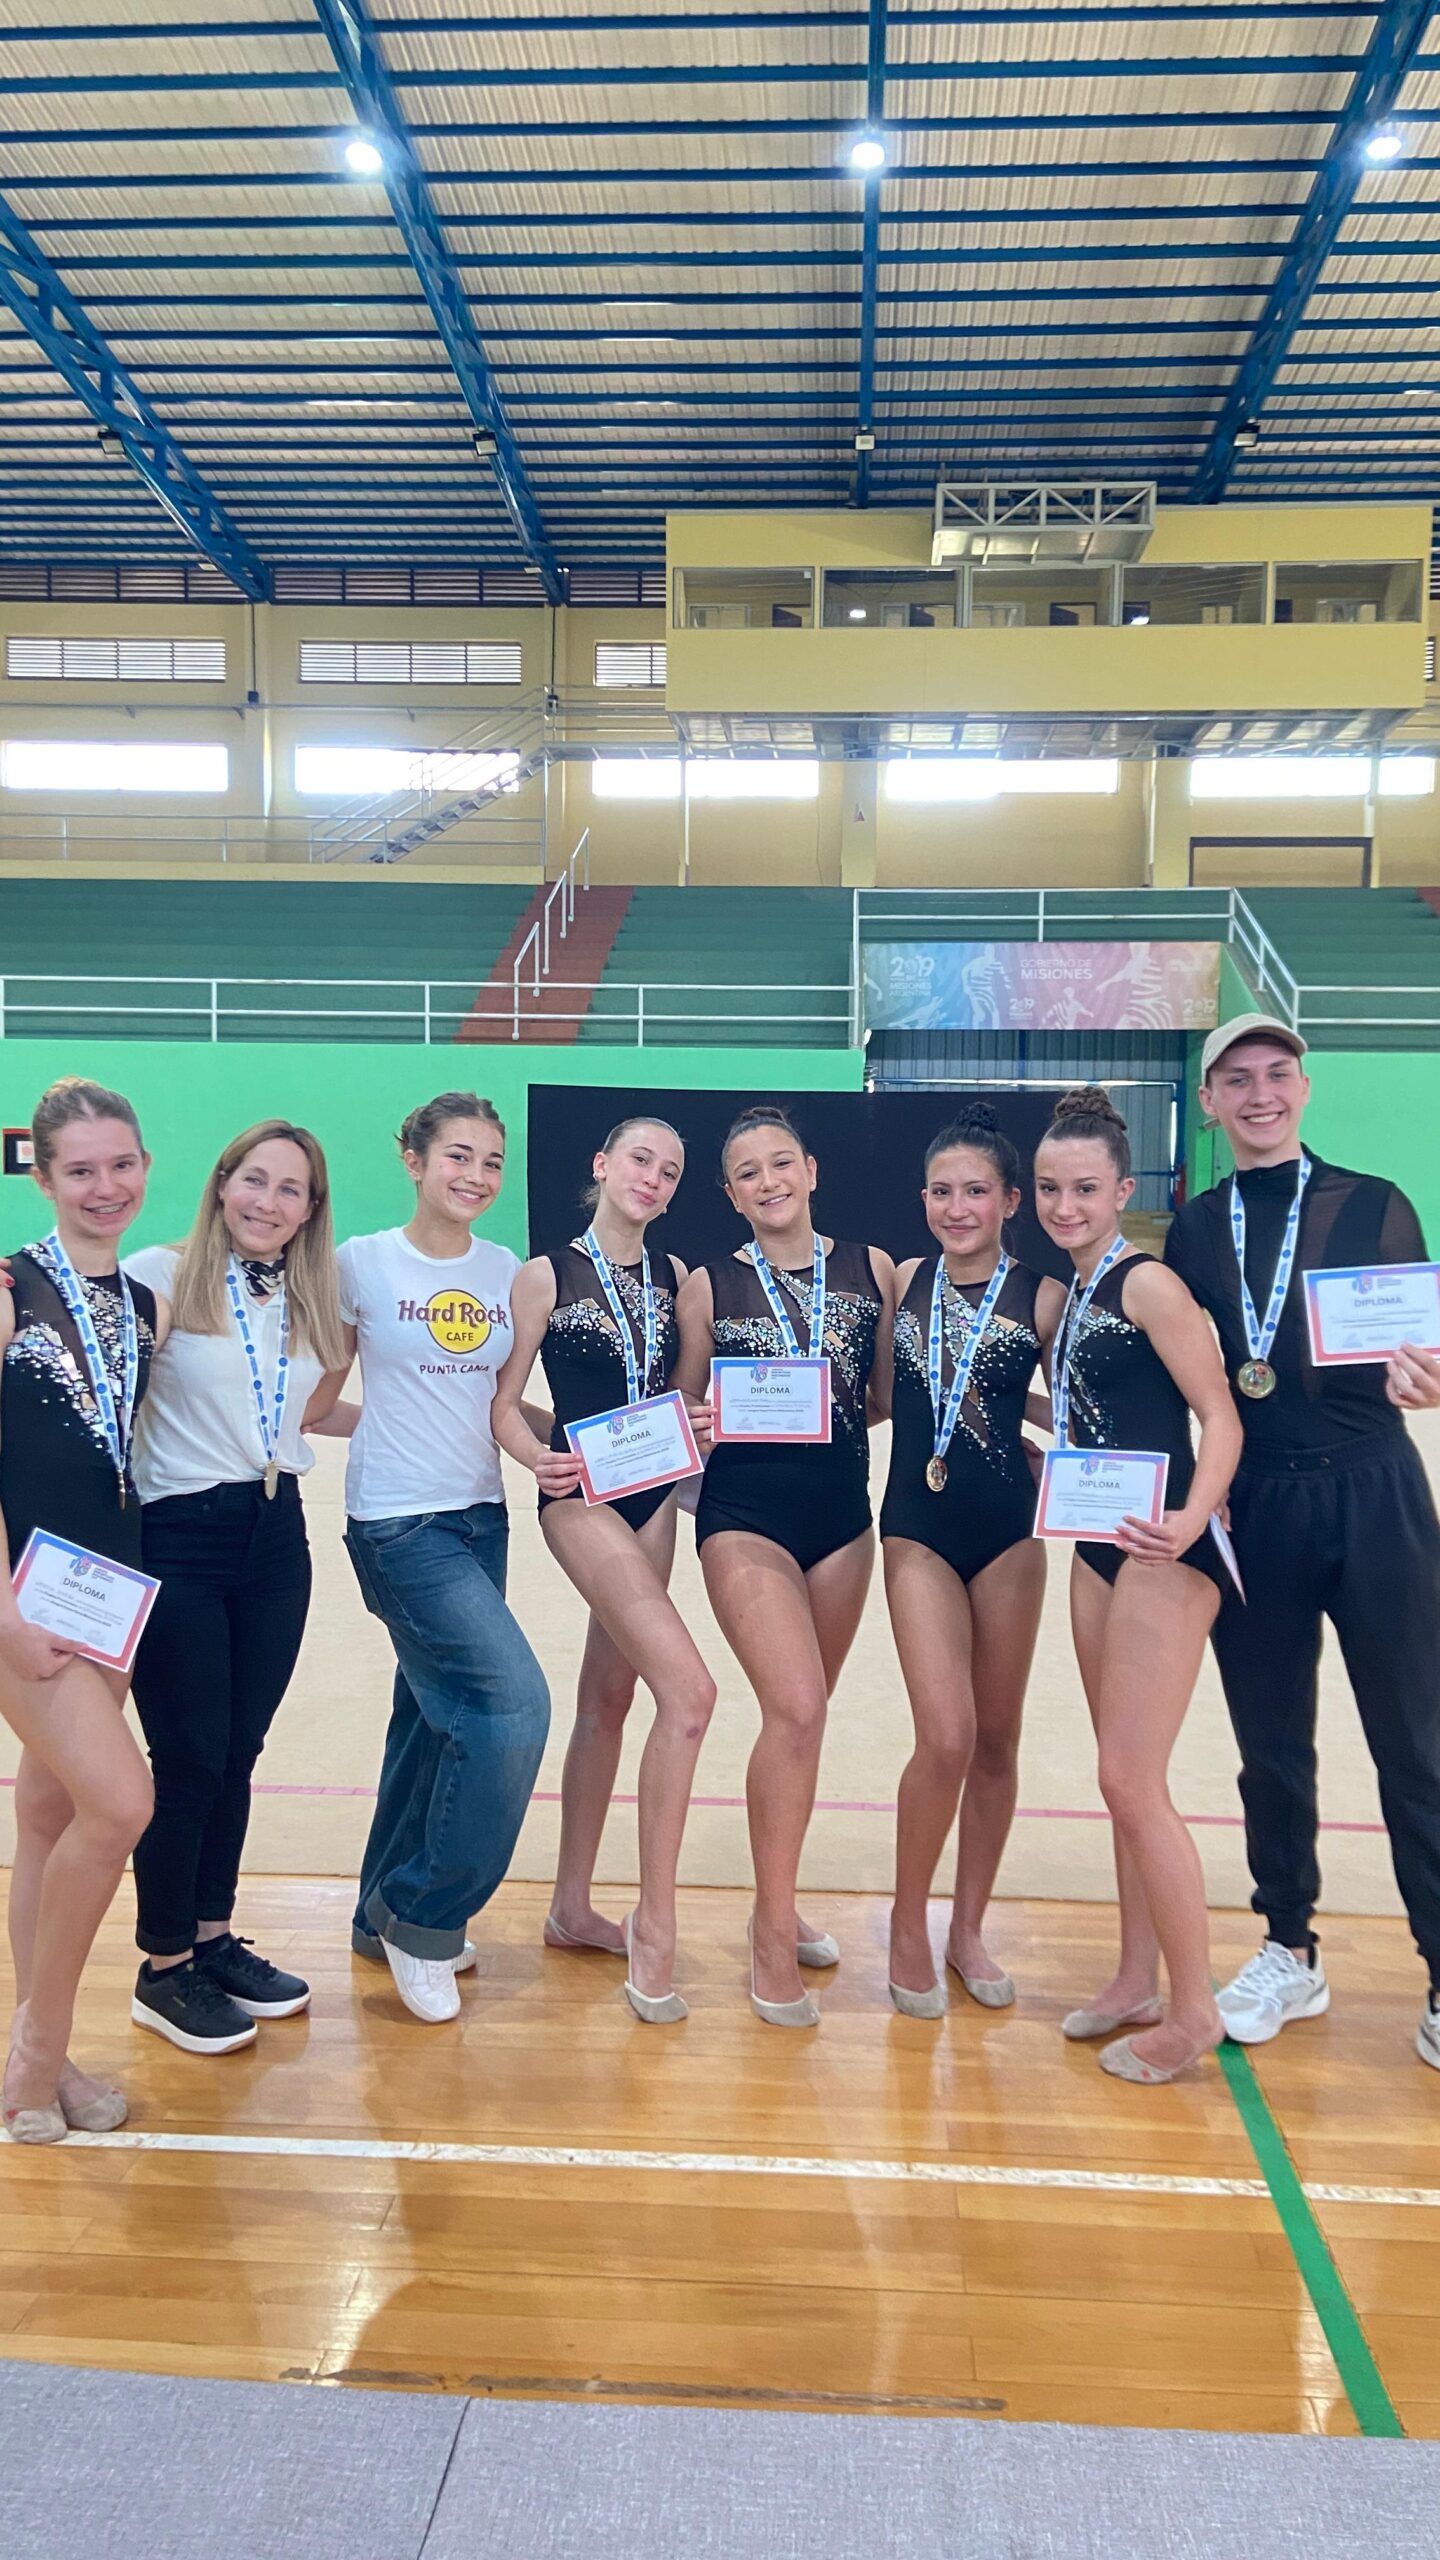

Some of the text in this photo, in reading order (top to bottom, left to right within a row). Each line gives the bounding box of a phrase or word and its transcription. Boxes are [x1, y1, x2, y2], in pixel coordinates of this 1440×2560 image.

[1020, 959, 1093, 967] GOBIERNO DE
[1020, 968, 1093, 980] MISIONES
[1354, 1297, 1404, 1308] DIPLOMA
[398, 1300, 509, 1329] Hard Rock
[446, 1332, 474, 1341] CAFE
[419, 1364, 457, 1374] PUNTA
[750, 1386, 790, 1394] DIPLOMA
[611, 1430, 651, 1448] DIPLOMA
[1079, 1480, 1121, 1489] DIPLOMA
[62, 1577, 106, 1602] DIPLOMA
